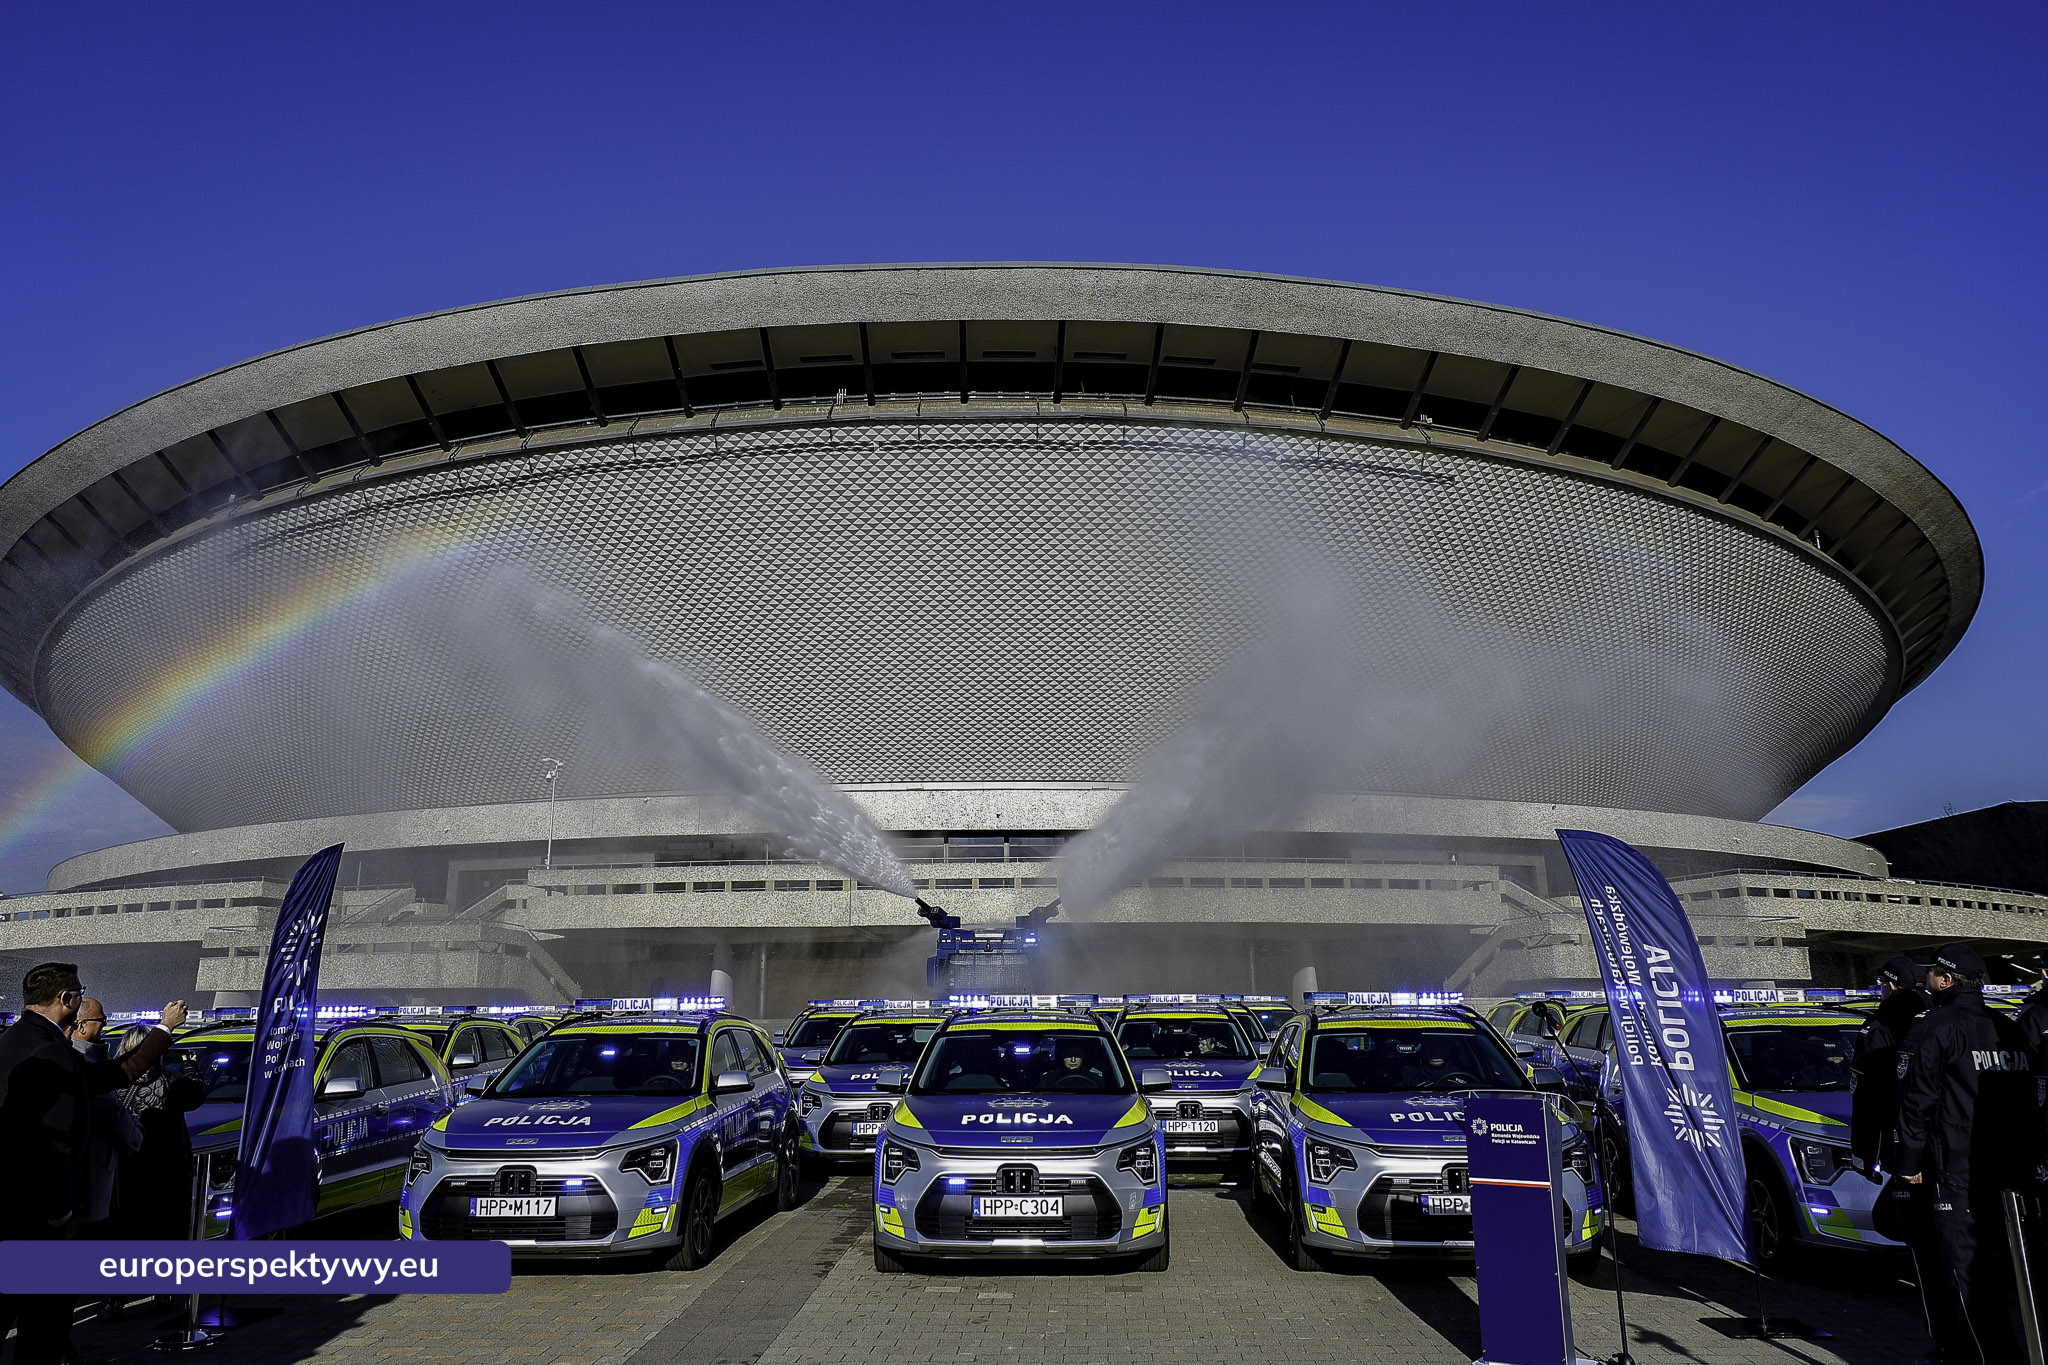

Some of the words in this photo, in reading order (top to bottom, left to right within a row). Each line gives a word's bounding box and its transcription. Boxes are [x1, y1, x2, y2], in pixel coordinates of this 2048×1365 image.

[1937, 956, 1957, 970] POLICJA
[990, 996, 1029, 1007] POLICJA
[1151, 995, 1179, 1003] POLICJA
[1349, 993, 1389, 1005] POLICJA
[1735, 990, 1777, 1002] POLICJA
[612, 999, 651, 1010] POLICJA
[884, 1001, 911, 1009] POLICJA
[1971, 1050, 2030, 1071] POLICJA
[483, 1115, 592, 1127] POLICJA
[961, 1112, 1074, 1125] POLICJA
[1389, 1111, 1466, 1123] POLIC
[326, 1116, 369, 1148] POLICJA
[1168, 1121, 1188, 1132] HPP
[1190, 1121, 1216, 1132] T120
[1490, 1123, 1524, 1132] POLICJA
[479, 1199, 509, 1216] HPP
[513, 1199, 552, 1216] M117
[983, 1199, 1014, 1216] HPP
[1019, 1199, 1060, 1216] C304
[1431, 1197, 1464, 1214] HPP
